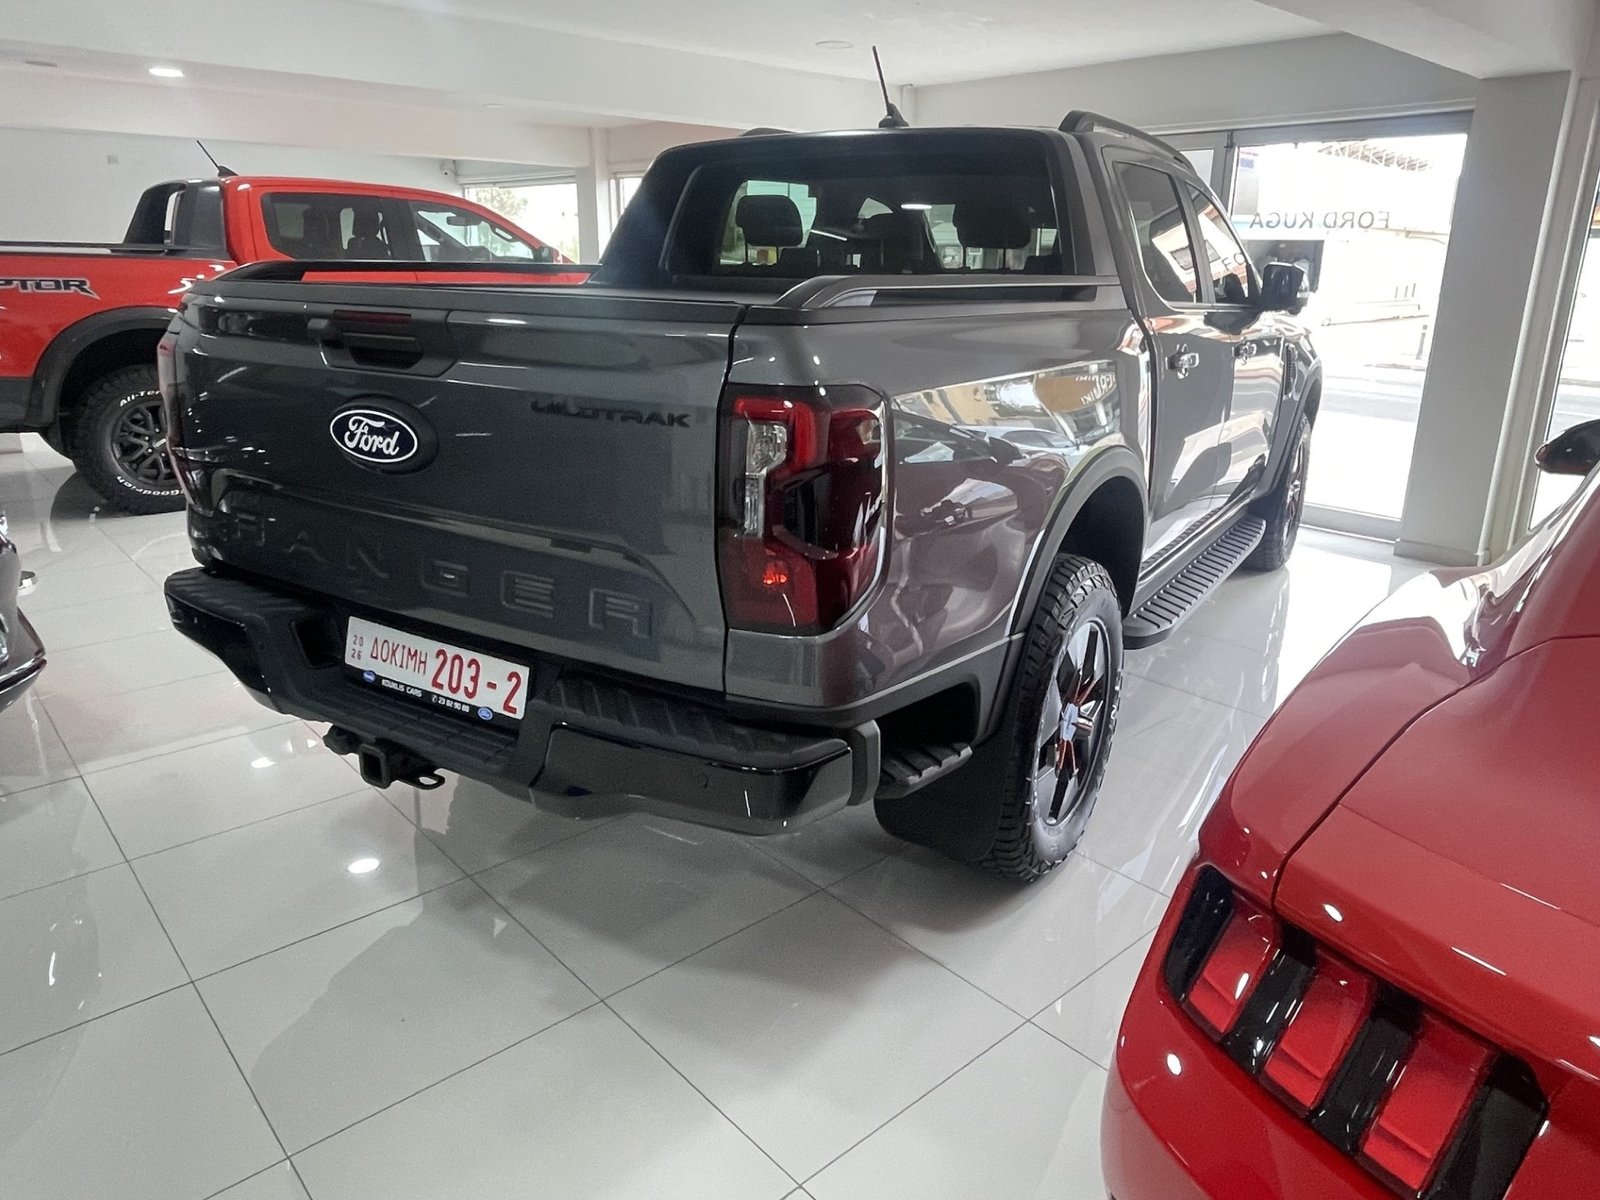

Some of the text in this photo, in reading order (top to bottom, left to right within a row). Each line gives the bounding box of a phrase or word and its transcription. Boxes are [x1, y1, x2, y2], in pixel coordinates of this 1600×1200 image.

[343, 415, 400, 456] Ford
[235, 510, 652, 639] RANGER
[351, 647, 362, 660] 26
[352, 634, 364, 647] 20
[370, 637, 428, 676] ΔΟΚΙΜΗ
